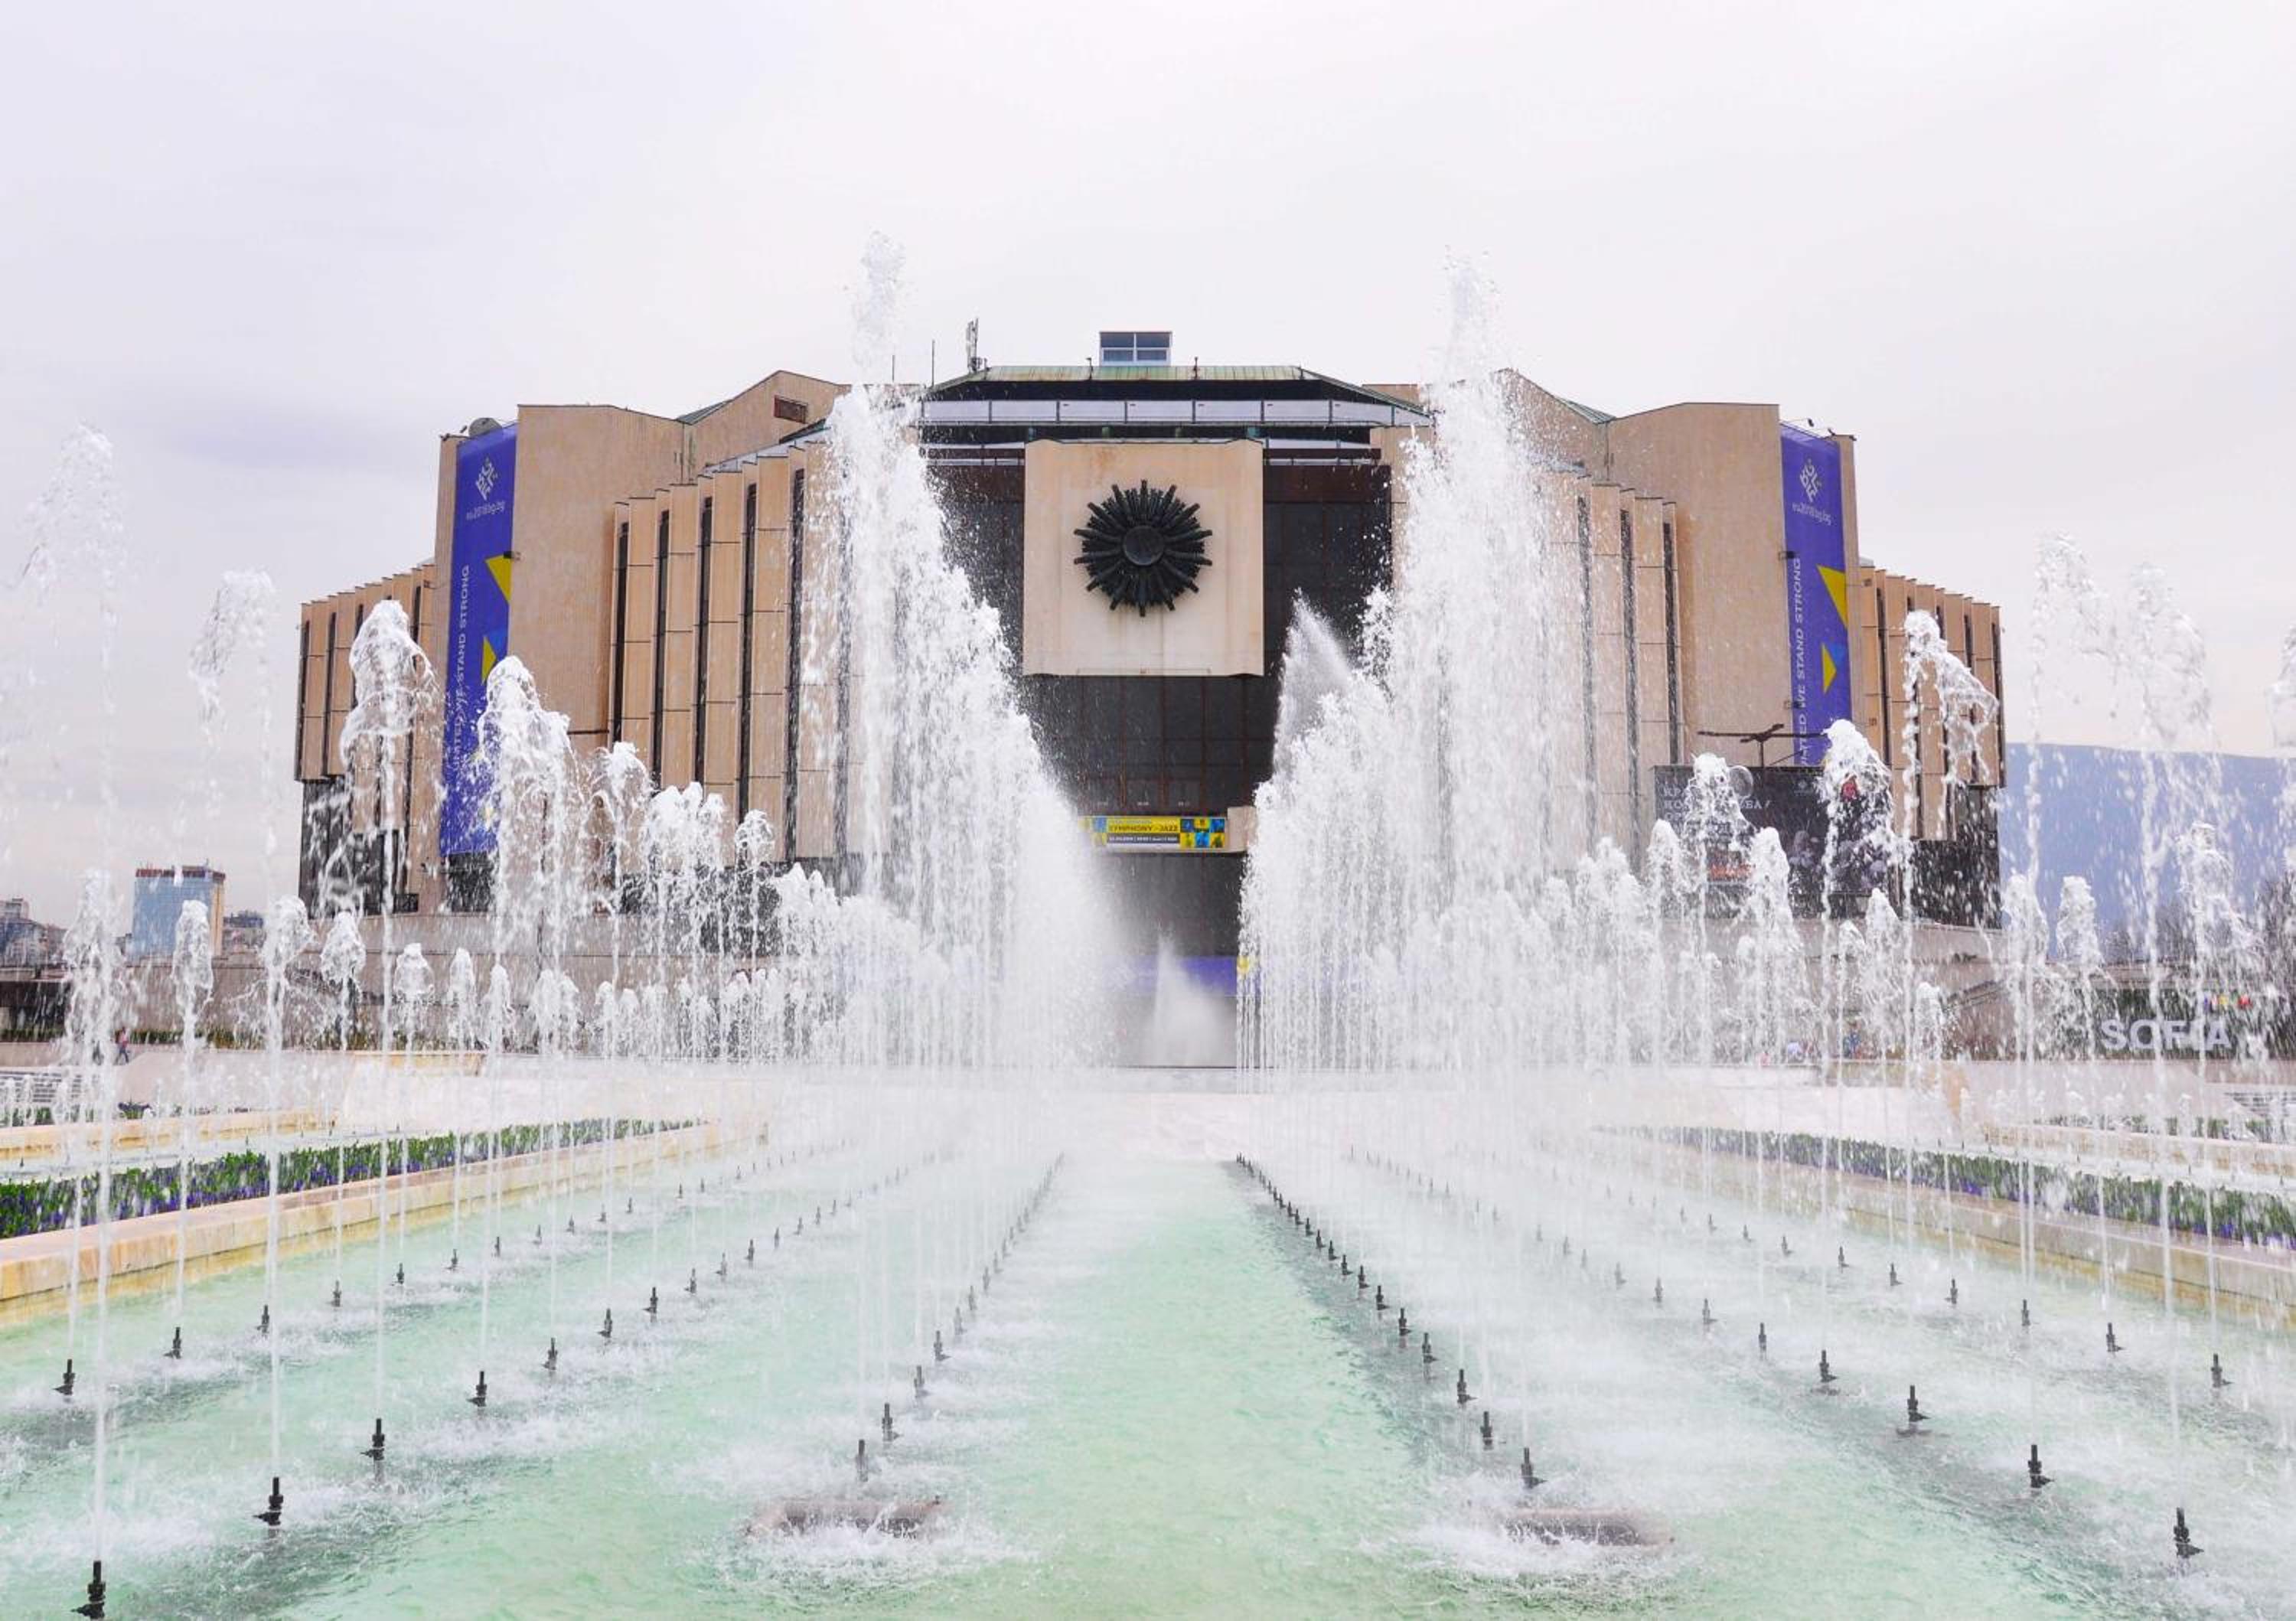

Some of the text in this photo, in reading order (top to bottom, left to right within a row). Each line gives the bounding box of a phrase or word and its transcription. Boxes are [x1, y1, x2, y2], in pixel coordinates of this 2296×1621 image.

[459, 565, 469, 628] STRONG
[1793, 556, 1803, 624] STRONG
[456, 633, 466, 683] STAND
[1795, 628, 1805, 680] STAND
